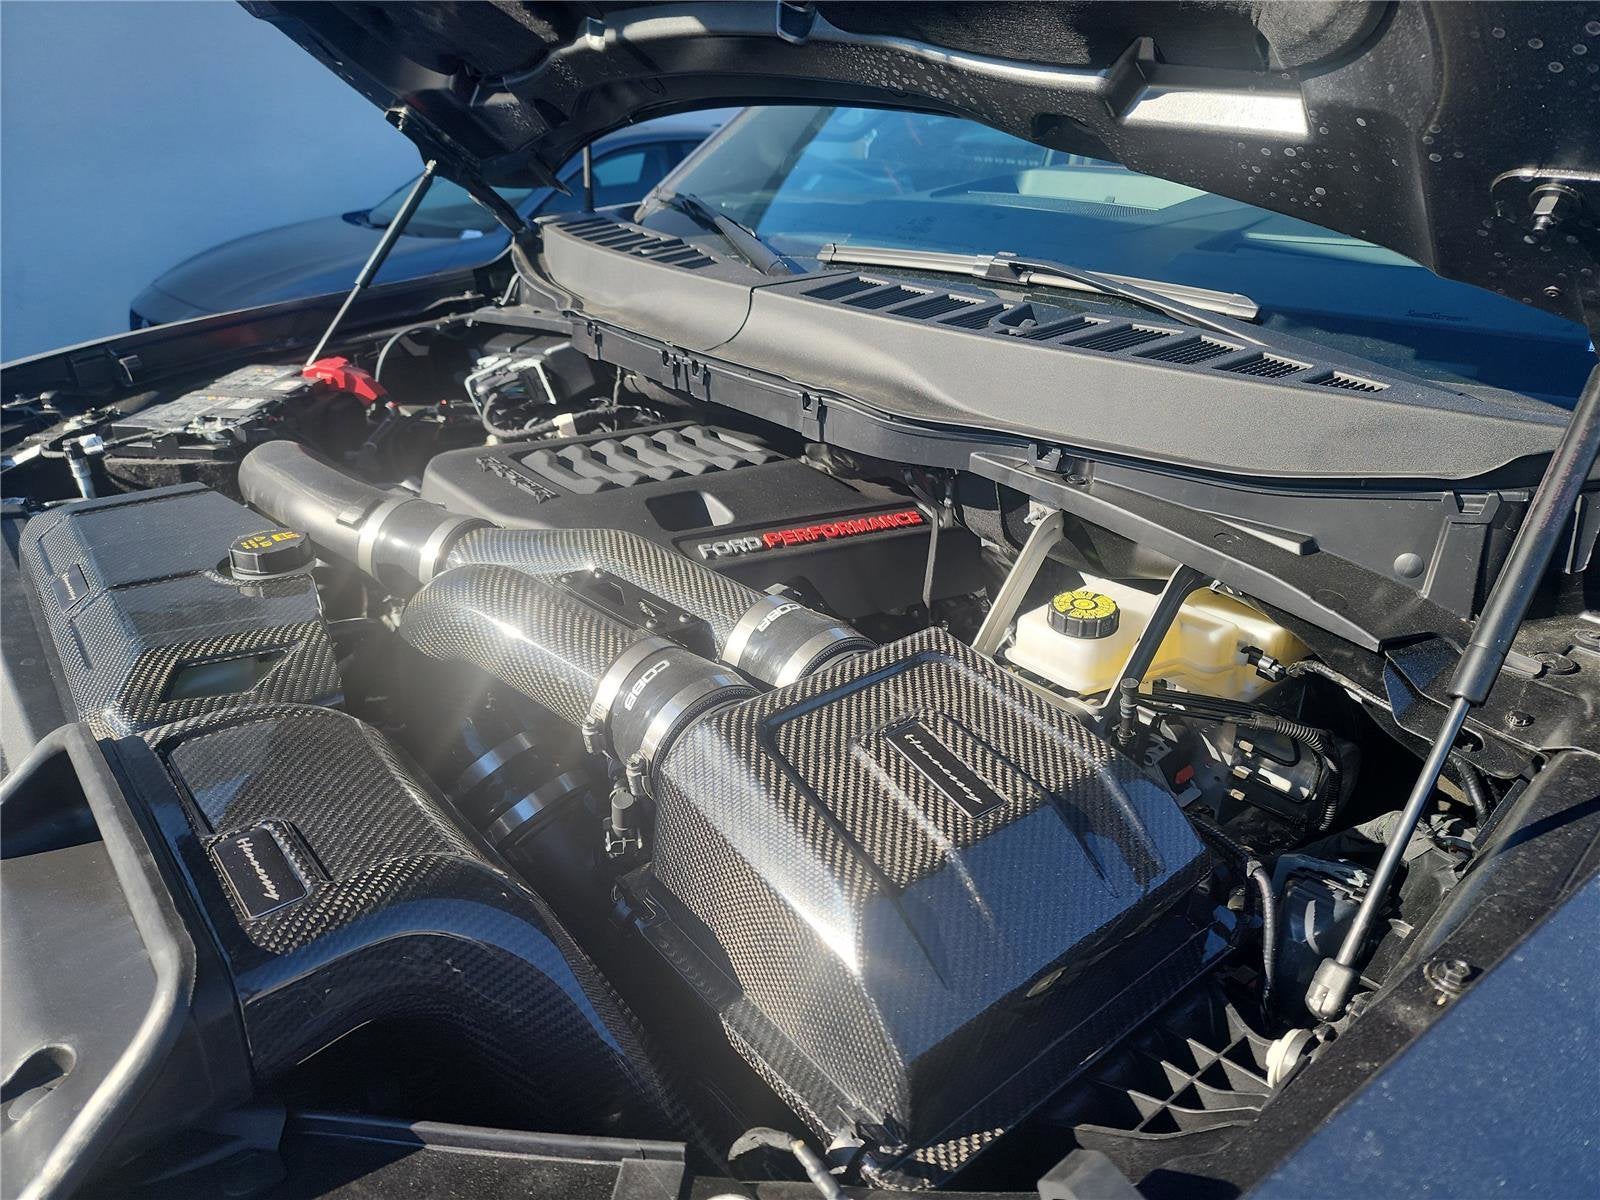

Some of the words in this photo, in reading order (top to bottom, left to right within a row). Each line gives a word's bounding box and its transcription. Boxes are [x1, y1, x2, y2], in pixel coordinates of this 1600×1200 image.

[698, 536, 763, 560] FORD
[763, 510, 923, 549] PERFORMANCE
[624, 660, 670, 711] COBB
[904, 734, 983, 804] Hennessey
[236, 837, 280, 901] Hennessey
